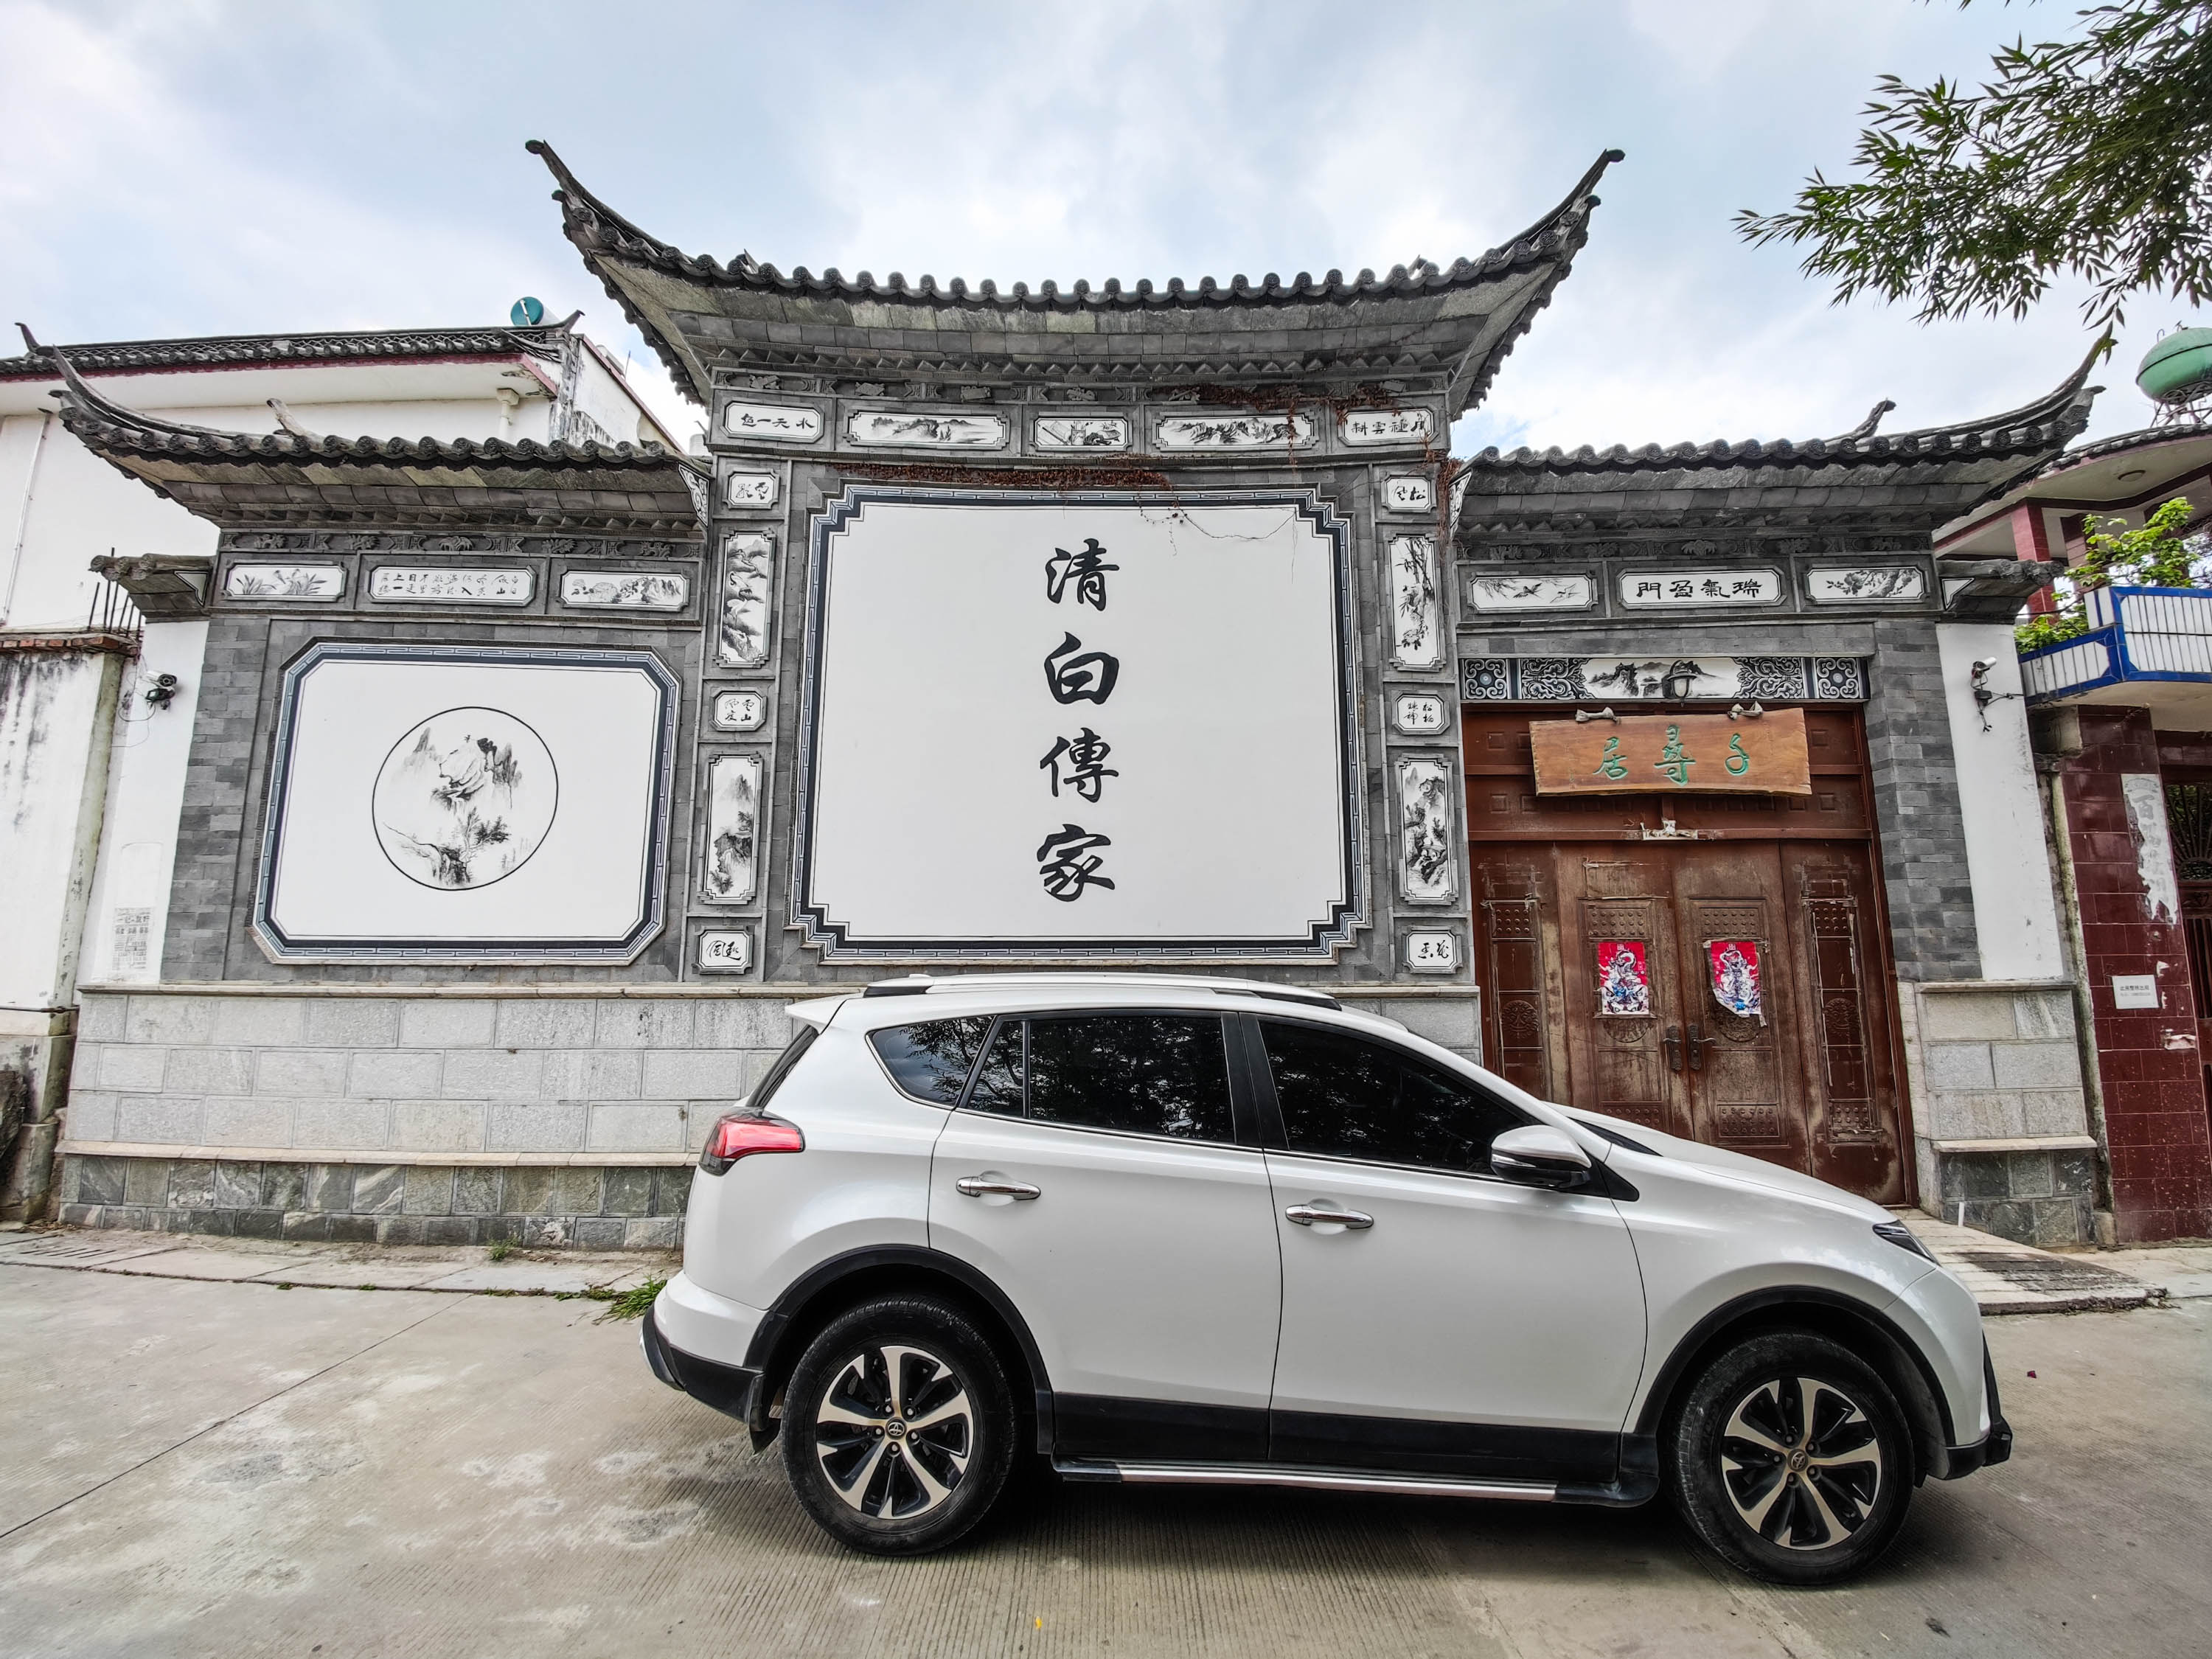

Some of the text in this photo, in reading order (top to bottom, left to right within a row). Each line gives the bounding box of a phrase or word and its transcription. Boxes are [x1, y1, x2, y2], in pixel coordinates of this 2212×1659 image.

[740, 413, 815, 430] 水天一色
[1636, 578, 1762, 599] 瑞氣盈門
[1036, 538, 1120, 902] 清白傳家
